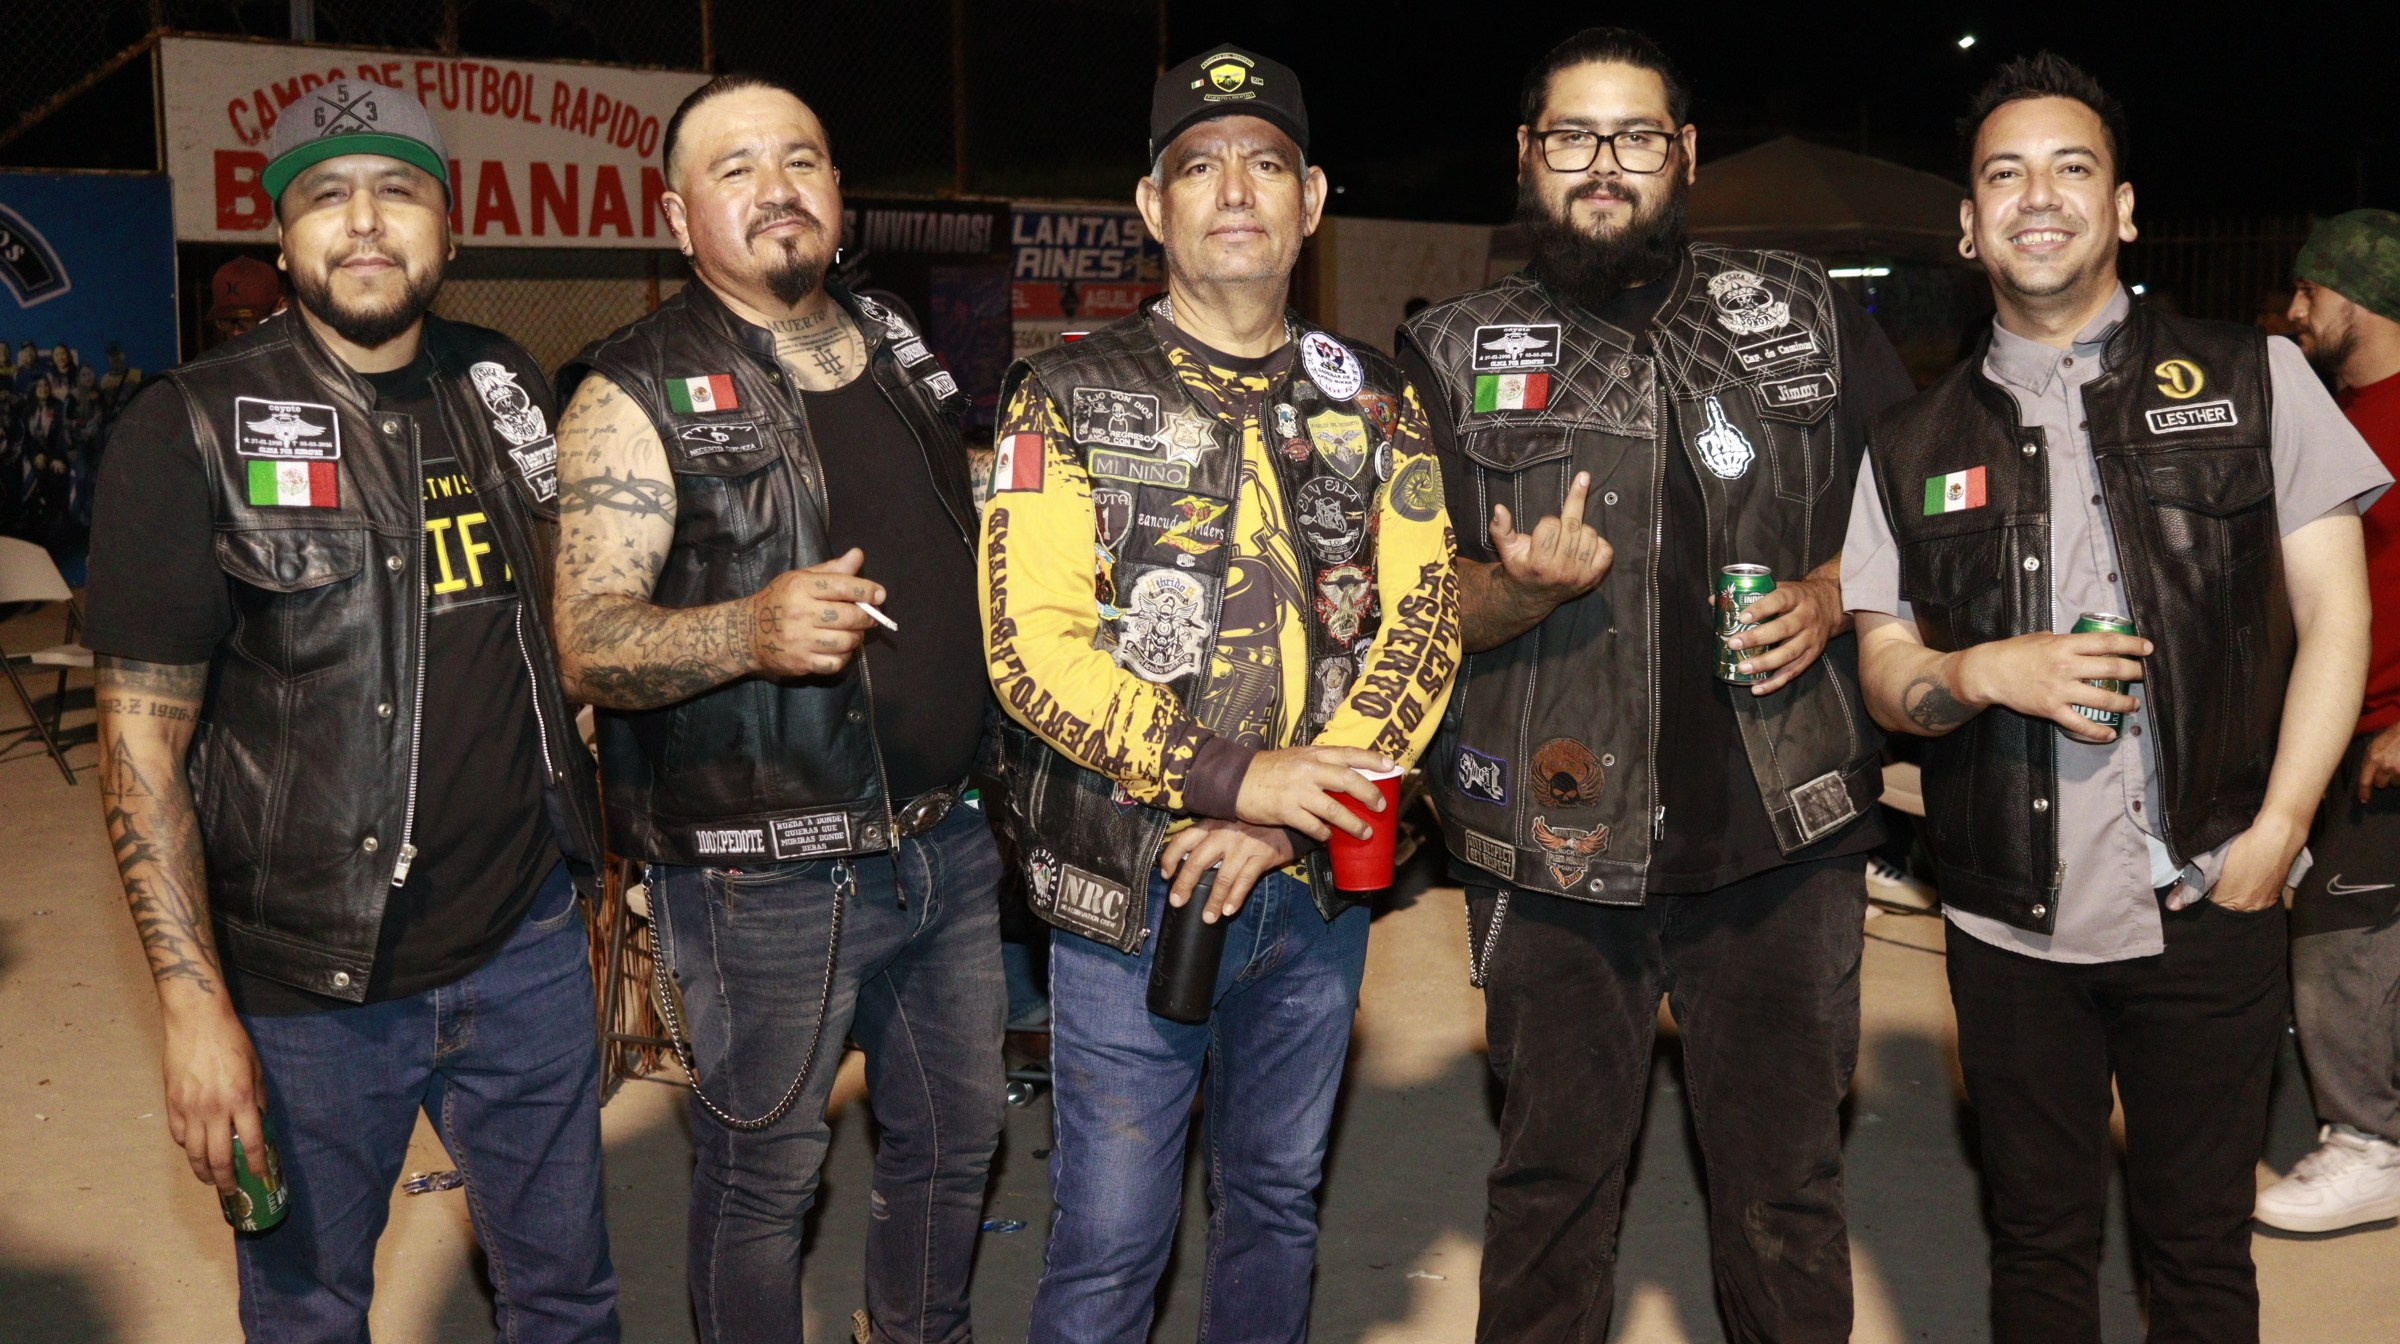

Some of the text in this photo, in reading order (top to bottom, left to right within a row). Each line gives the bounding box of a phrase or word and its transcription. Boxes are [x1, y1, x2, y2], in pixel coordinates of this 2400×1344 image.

[415, 61, 542, 123] FUTBOL
[551, 80, 660, 158] RAPIDO
[864, 210, 993, 254] INVITADOS!
[1015, 249, 1126, 279] RINES
[767, 309, 826, 334] MUERTO
[1765, 349, 1776, 358] de
[1778, 381, 1819, 401] Jimmy
[269, 405, 302, 414] coyote
[1110, 392, 1132, 403] CON
[1133, 401, 1154, 419] DIOS
[2157, 407, 2227, 428] LESTHER
[1088, 434, 1110, 443] ANDO
[1113, 437, 1131, 446] CON
[1092, 427, 1106, 436] NO
[1096, 458, 1183, 484] MI NIÑO
[1093, 493, 1131, 505] RUTA
[1325, 480, 1358, 501] ELLA
[1101, 507, 1111, 541] 1
[1194, 521, 1225, 541] riders
[988, 508, 1133, 780] PUERTO LIBERTAD
[777, 819, 803, 831] RUEDA
[816, 814, 843, 825] DONDE
[785, 824, 838, 838] QUIERAS QUE
[780, 832, 845, 847] MORIRAS DONDE
[1482, 839, 1512, 860] RESPECT
[1470, 847, 1511, 875] GET RESPECT
[1062, 874, 1124, 920] NRC
[1100, 917, 1117, 929] CREW
